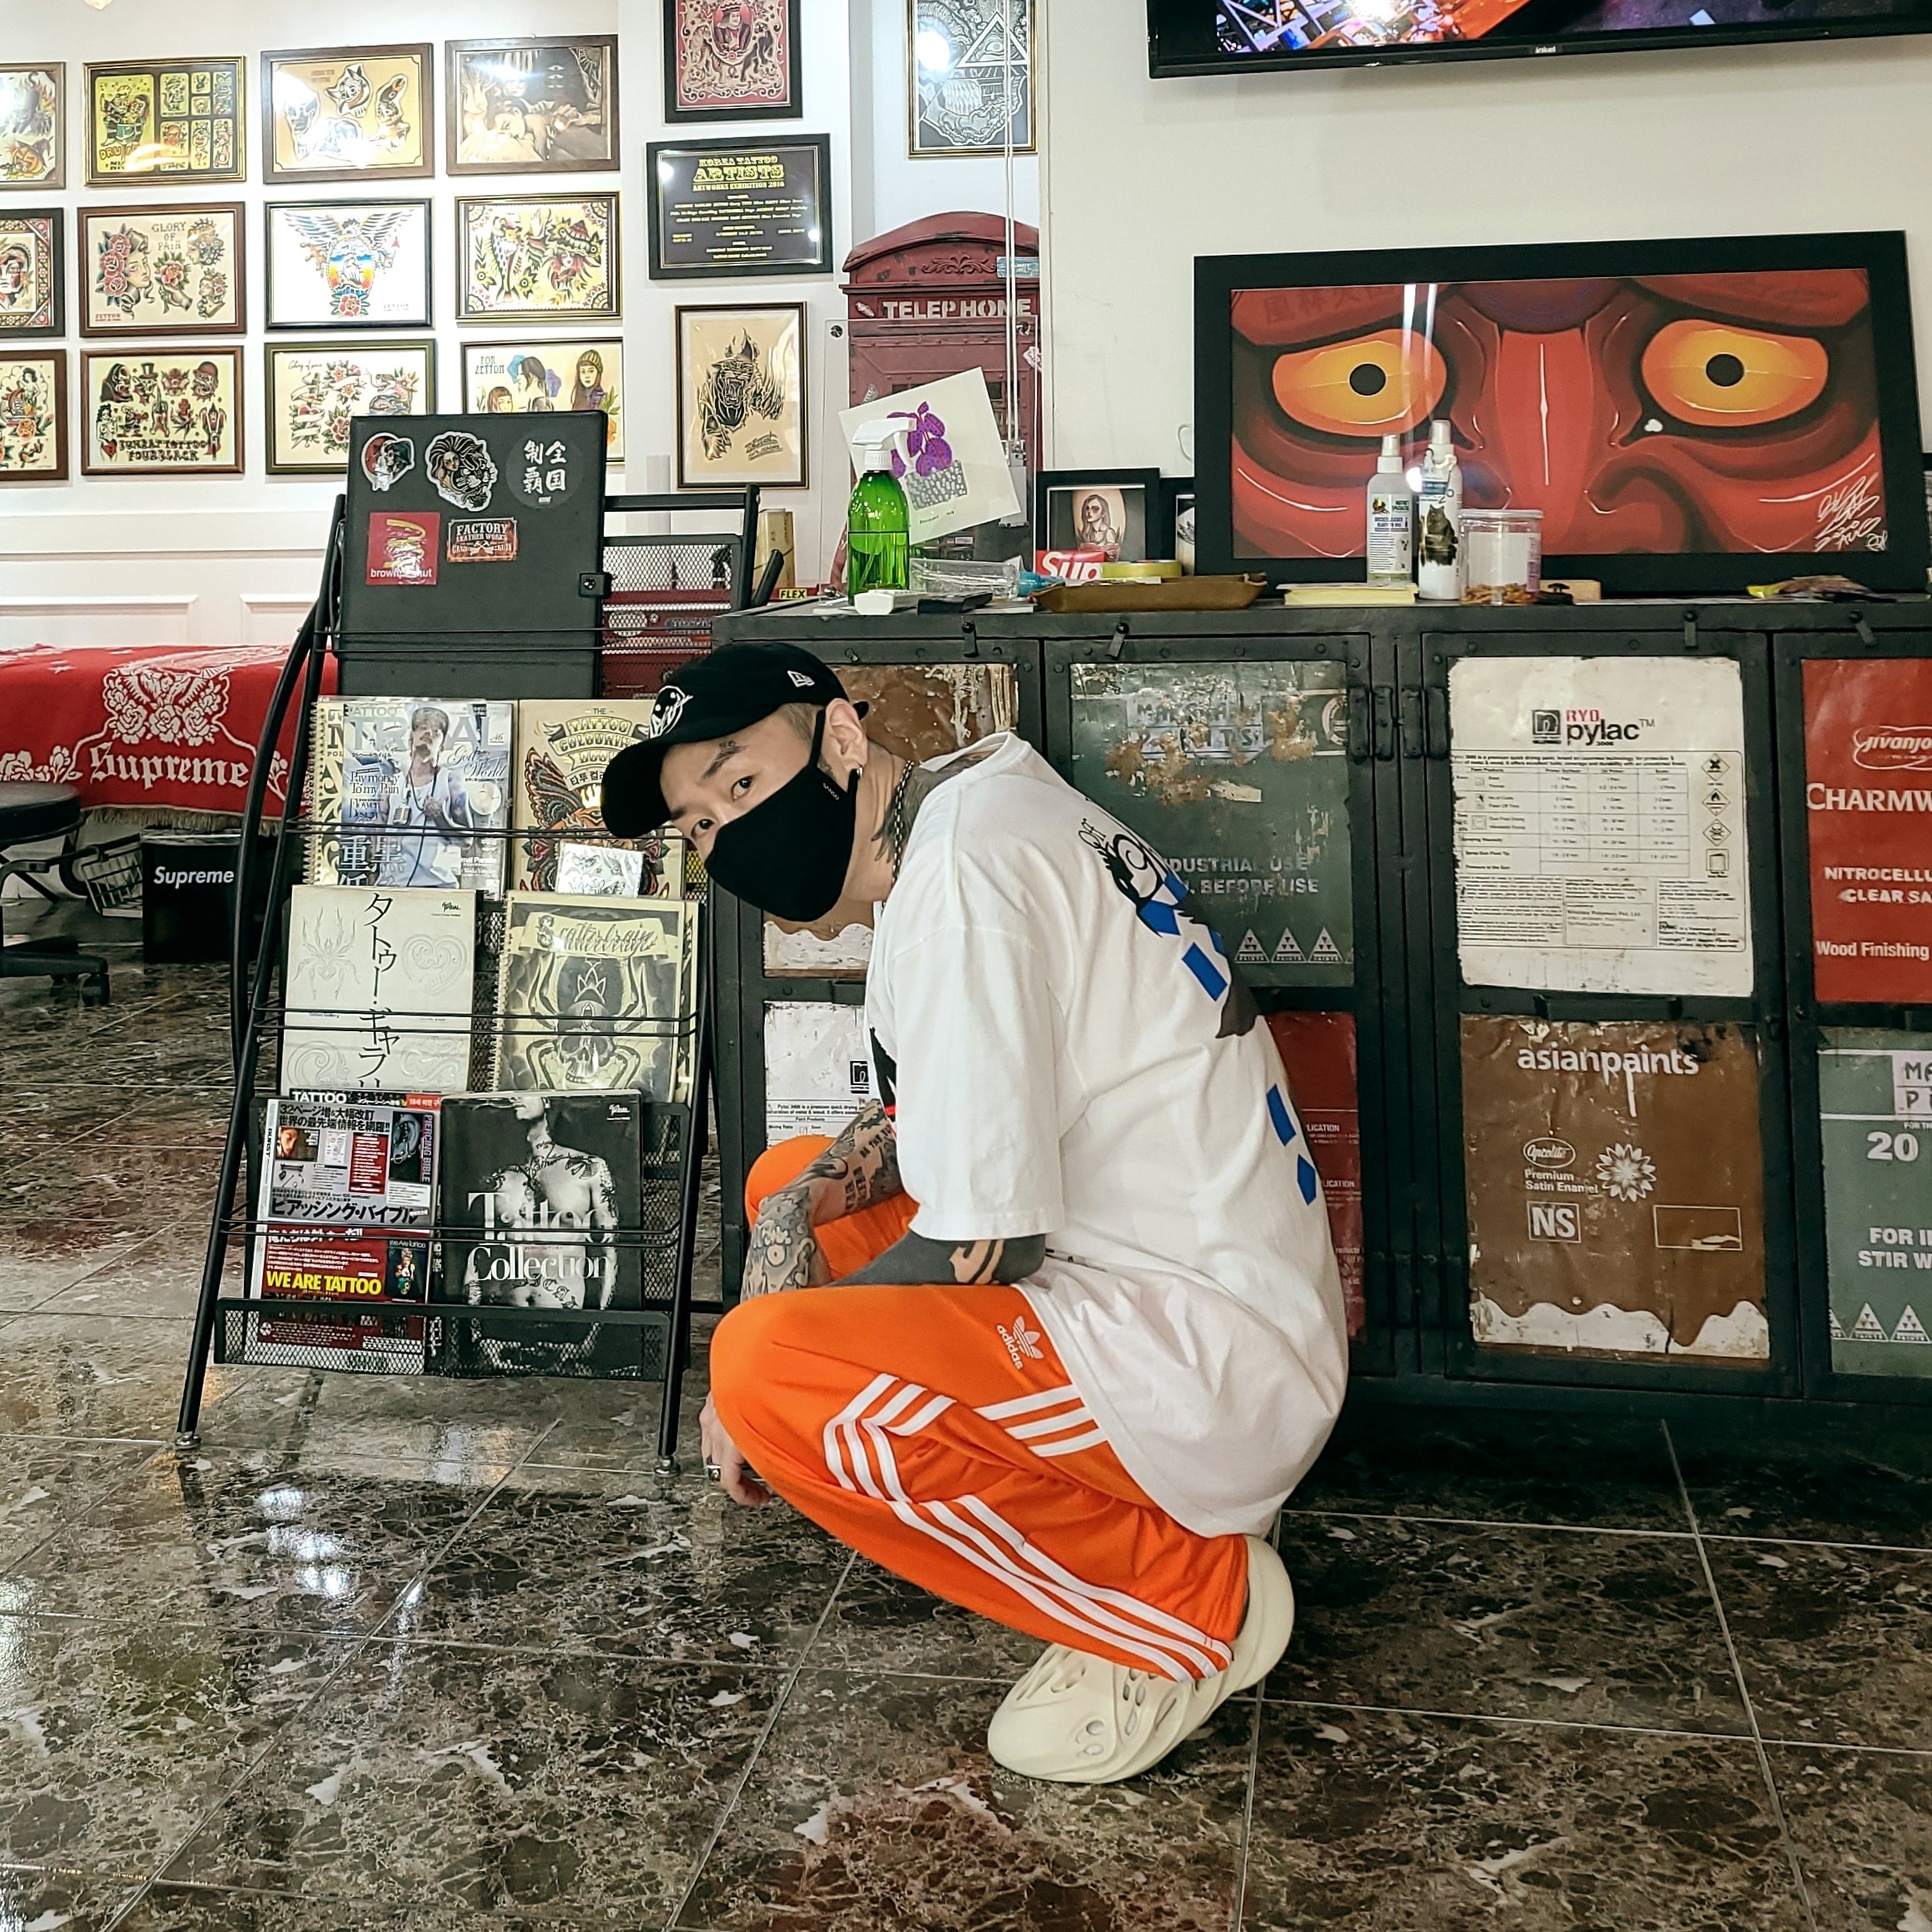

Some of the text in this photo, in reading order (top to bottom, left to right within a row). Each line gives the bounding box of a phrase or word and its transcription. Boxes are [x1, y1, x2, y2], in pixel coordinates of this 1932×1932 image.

[737, 156, 778, 164] TATTOO
[693, 164, 785, 182] ARTISTS
[152, 221, 186, 232] GLORY
[163, 233, 176, 241] OF
[883, 299, 1031, 318] TELEPHONE
[456, 522, 509, 534] FACTORY
[781, 590, 806, 598] FLEX
[1565, 709, 1600, 722] RYO
[344, 716, 496, 752] TRAL
[570, 718, 630, 733] TATTOO
[1566, 718, 1640, 746] pylac
[559, 733, 644, 752] COLOURIN
[90, 742, 249, 791] Supreme
[153, 866, 235, 889] Supreme
[1839, 888, 1904, 903] CLEAR
[1815, 941, 1930, 961] Wood Finishing
[1517, 1041, 1700, 1083] asianpaints
[292, 1091, 348, 1104] TATTOO
[421, 1114, 434, 1184] PIERCING BIBLE
[1866, 1131, 1919, 1161] 20
[1525, 1169, 1574, 1181] Premium
[1525, 1180, 1555, 1191] Satin
[1531, 1207, 1575, 1238] NS
[1869, 1227, 1914, 1245] FOR
[466, 1246, 610, 1281] Collection
[1858, 1250, 1909, 1268] STIR
[266, 1271, 382, 1295] WE ARE TATTOO
[996, 1324, 1023, 1370] adidas
